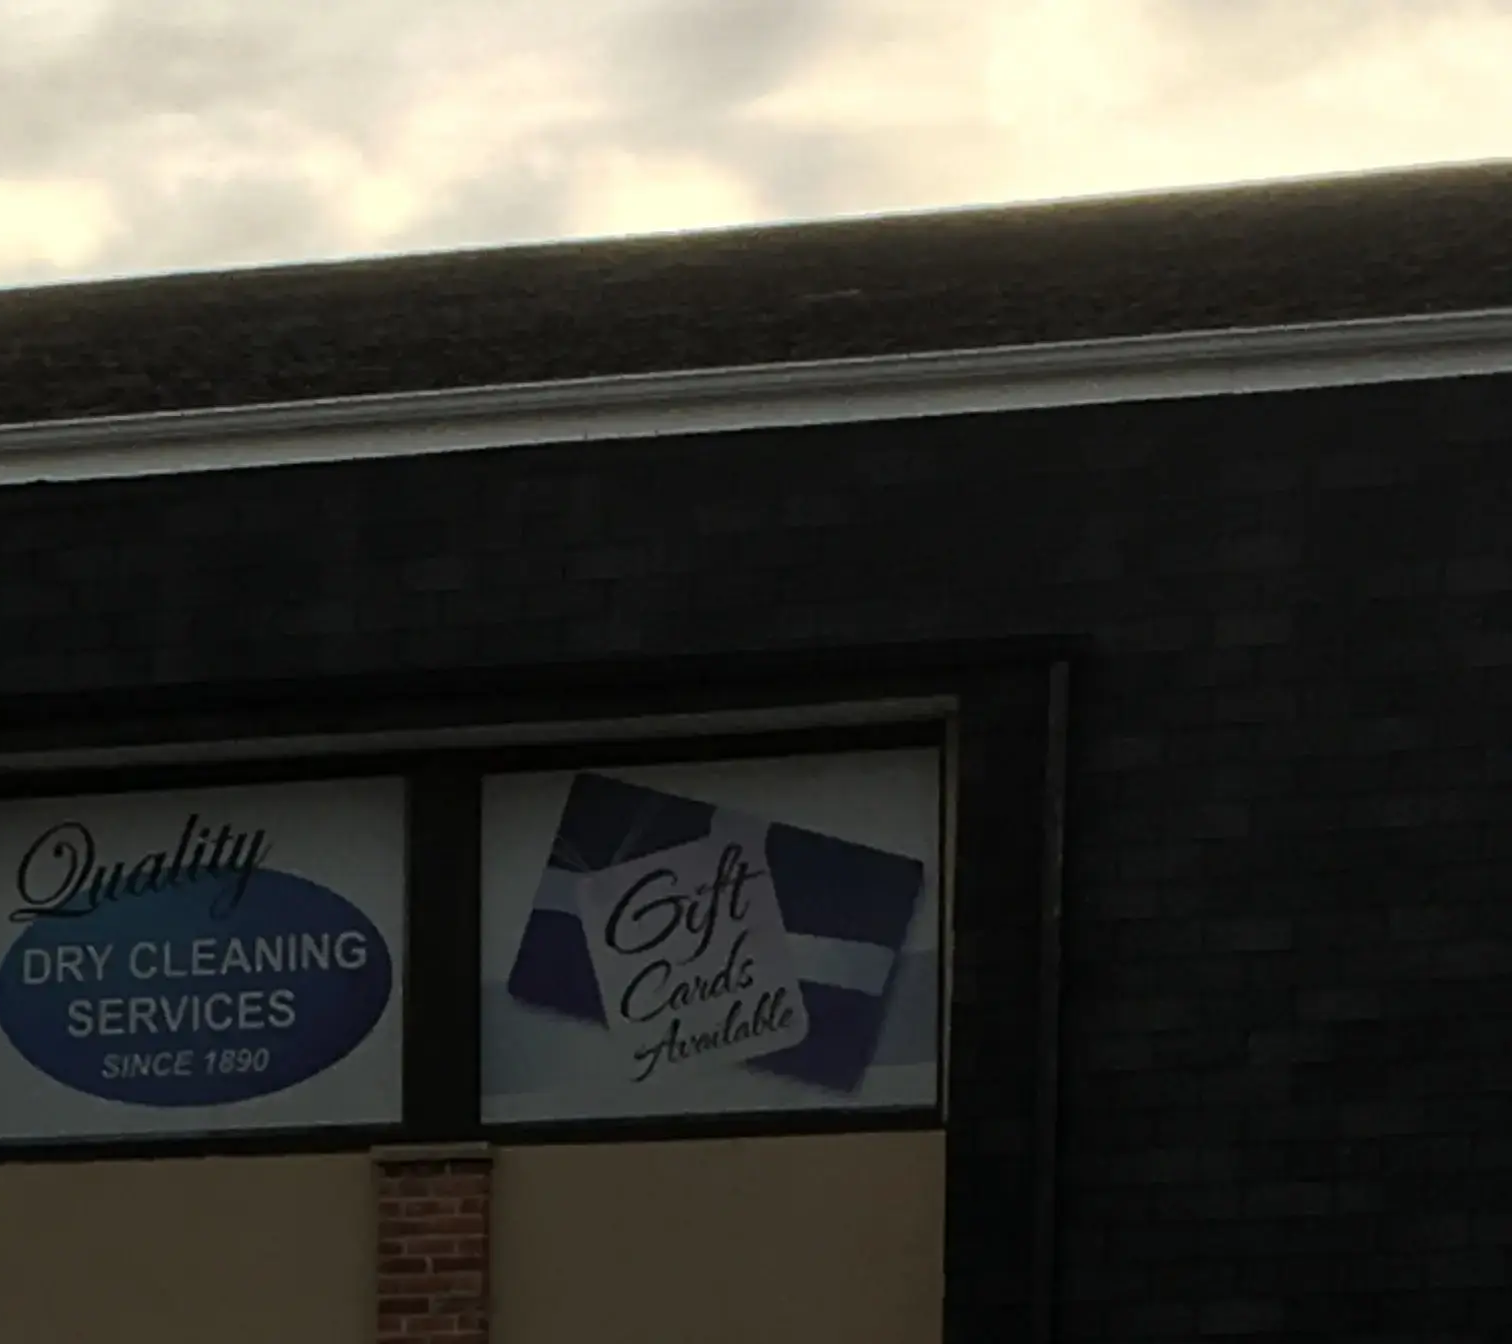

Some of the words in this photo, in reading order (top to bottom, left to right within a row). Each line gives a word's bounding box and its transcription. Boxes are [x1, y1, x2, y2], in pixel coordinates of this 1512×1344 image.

[9, 814, 271, 922] Quality
[605, 842, 766, 963] Gift
[22, 943, 113, 985] DRY
[129, 930, 368, 980] CLEANING
[620, 929, 755, 1024] Cards
[67, 988, 296, 1038] SERVICES
[632, 987, 793, 1082] Available
[101, 1051, 194, 1080] SINCE
[205, 1047, 271, 1074] 1890
